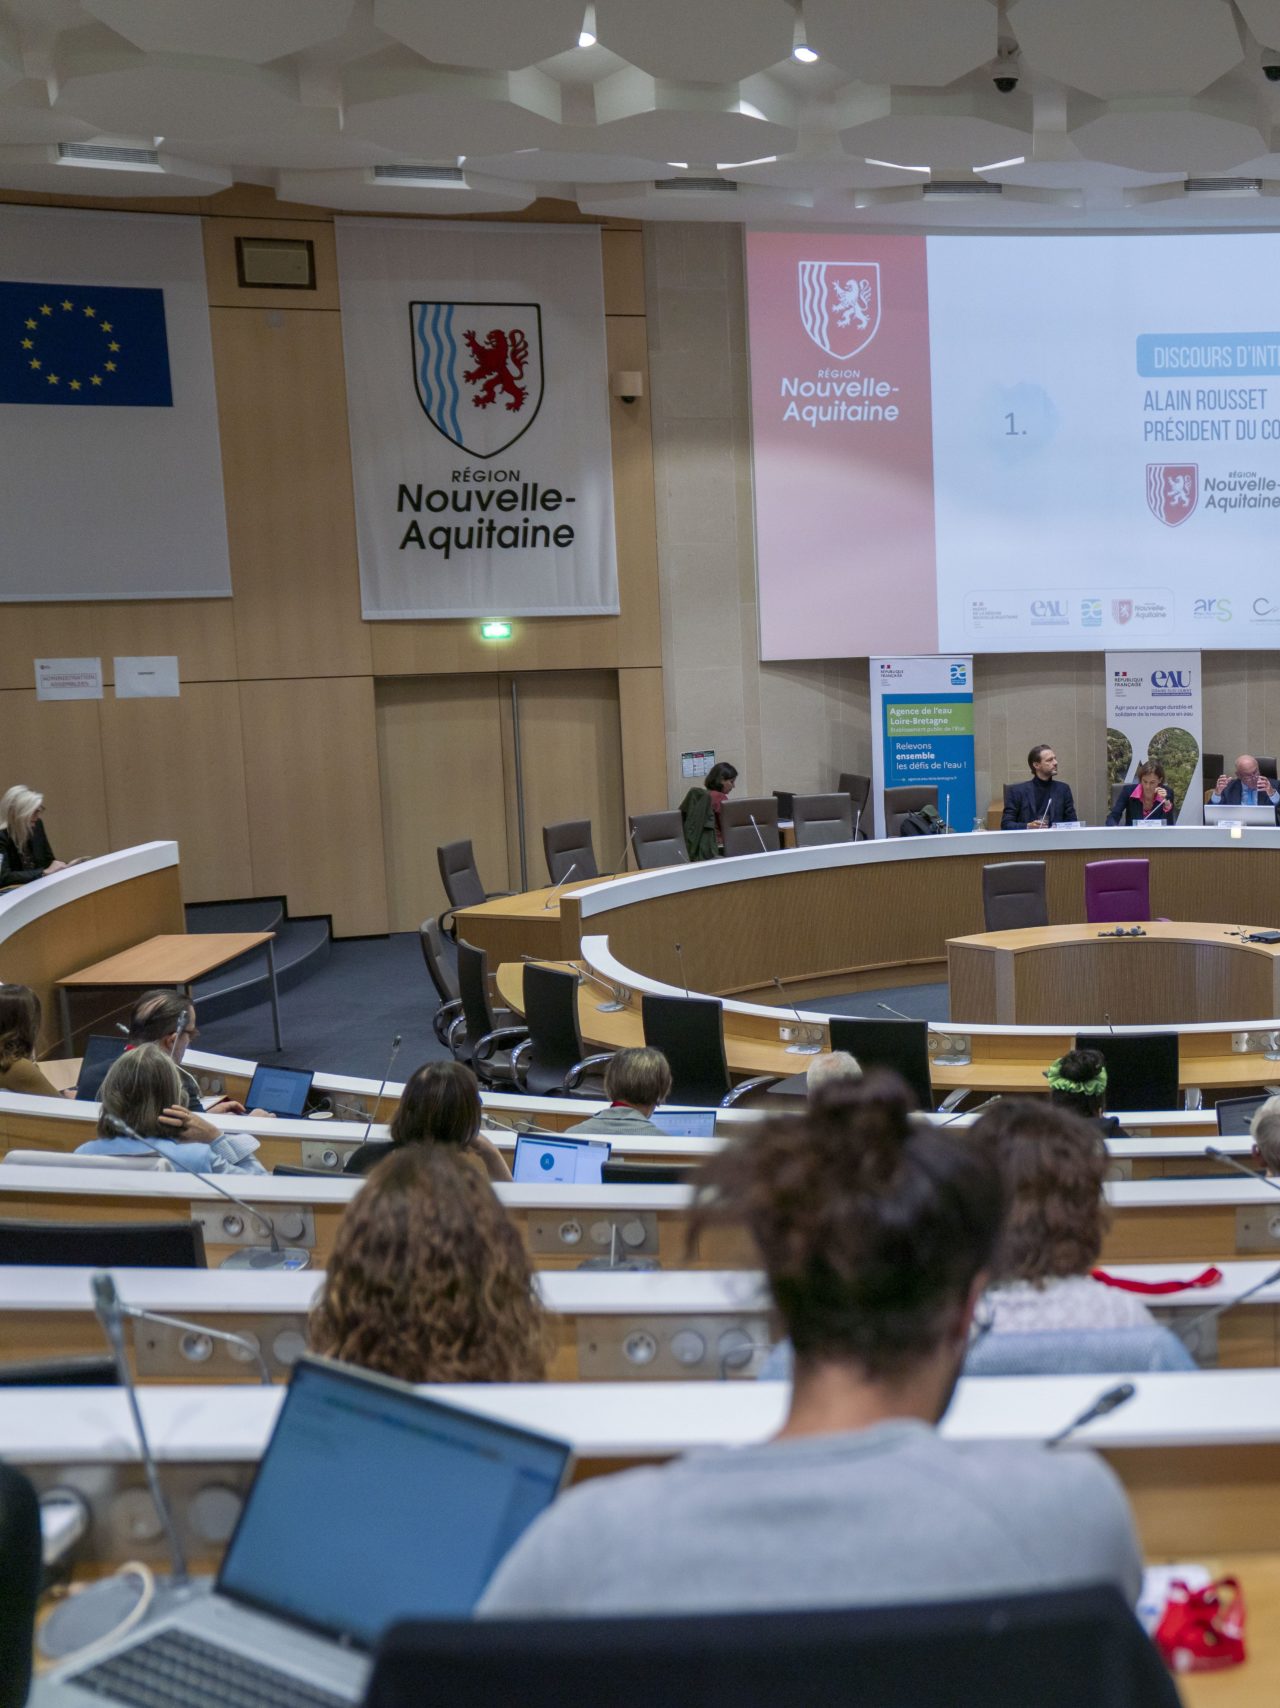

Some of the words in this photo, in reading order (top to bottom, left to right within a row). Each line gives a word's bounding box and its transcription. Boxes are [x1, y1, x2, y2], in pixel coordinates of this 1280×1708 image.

[1154, 346, 1232, 369] DISCOURS
[818, 369, 860, 379] RÉGION
[781, 378, 899, 397] Nouvelle-
[1144, 390, 1192, 411] ALAIN
[1196, 389, 1267, 410] ROUSSET
[783, 400, 899, 427] Aquitaine
[1004, 412, 1027, 436] 1.
[1144, 418, 1231, 441] PRÉSIDENT
[1237, 420, 1257, 440] DU
[452, 467, 521, 483] RÉGION
[1228, 470, 1257, 478] RÉGION
[397, 483, 575, 512] Nouvelle-
[398, 517, 575, 559] Aquitaine
[890, 707, 919, 717] Agence
[890, 717, 948, 726] Loire-Bretagne
[896, 752, 935, 760] ensemble
[896, 762, 907, 770] les
[909, 762, 929, 770] défis
